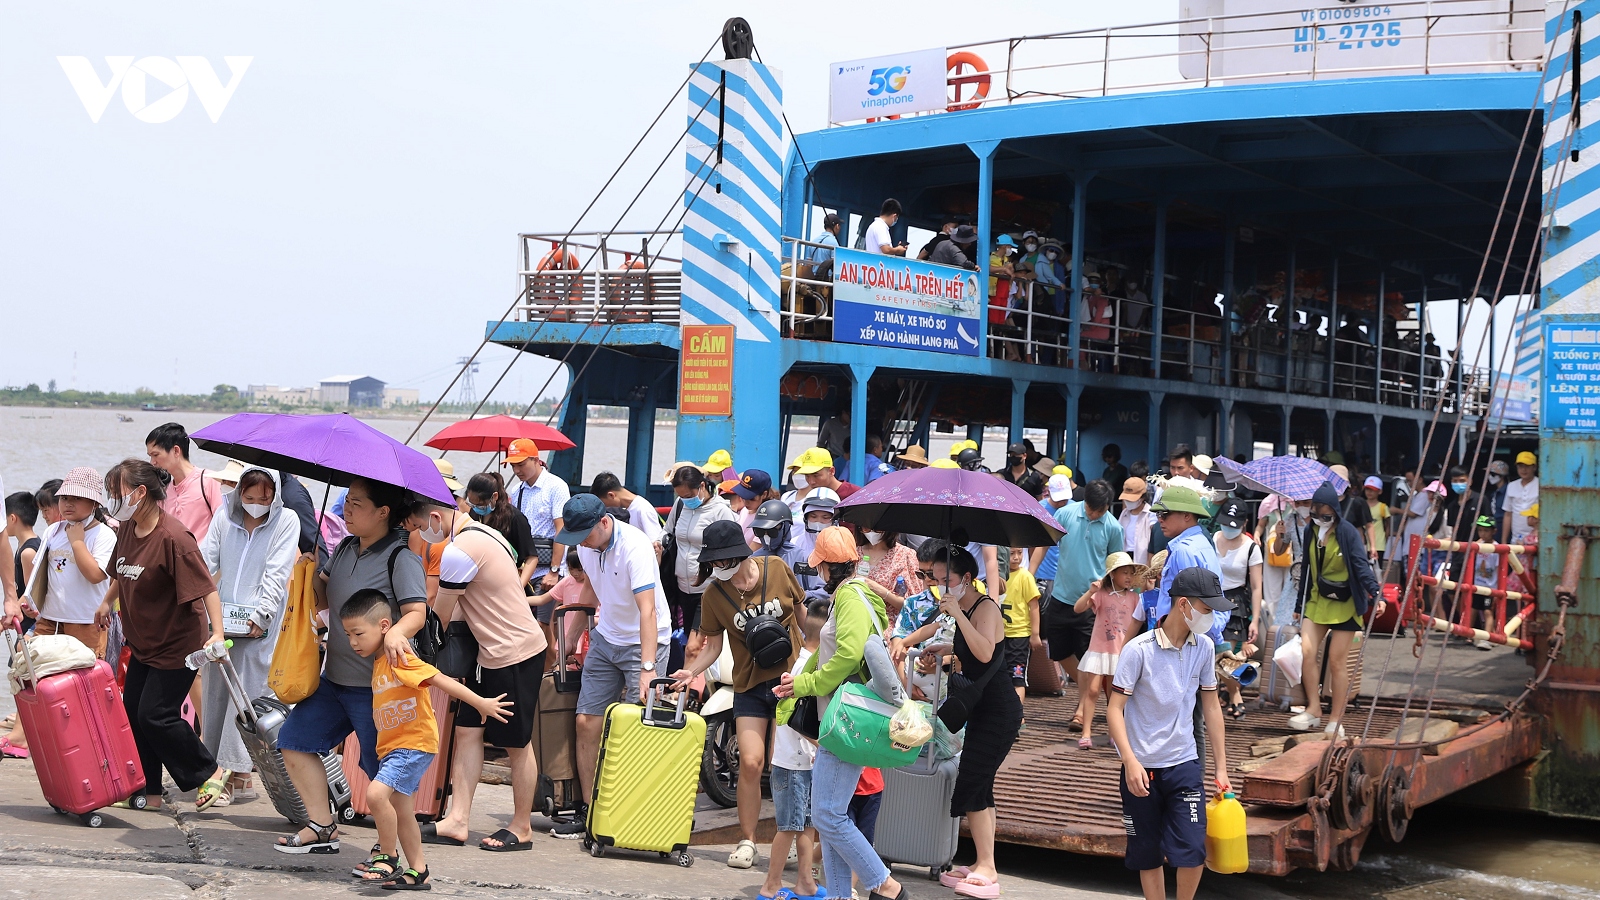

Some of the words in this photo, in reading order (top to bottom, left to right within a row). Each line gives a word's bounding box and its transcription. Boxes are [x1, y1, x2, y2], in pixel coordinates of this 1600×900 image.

[861, 94, 914, 108] vinaphone
[840, 262, 858, 284] AN
[862, 262, 895, 290] TOÀN
[898, 266, 912, 292] LÀ
[916, 270, 942, 297] TRÊN
[946, 273, 964, 300] HẾT
[876, 294, 910, 305] SAFETY
[912, 300, 937, 309] FIRST
[874, 311, 885, 322] XE
[908, 316, 917, 327] XE
[919, 316, 934, 328] THÔ
[936, 318, 946, 330] SƠ
[690, 330, 725, 353] CẤM
[860, 325, 875, 340] XẾP
[878, 328, 895, 342] VÀO
[898, 331, 920, 345] HÀNH
[922, 336, 942, 348] LANG
[944, 336, 958, 350] PHÀ
[1552, 348, 1590, 360] XUỐNG
[1550, 382, 1579, 393] LÊN
[1117, 411, 1140, 422] WC
[1577, 418, 1597, 427] TOÀN
[1190, 803, 1198, 822] SAFE
